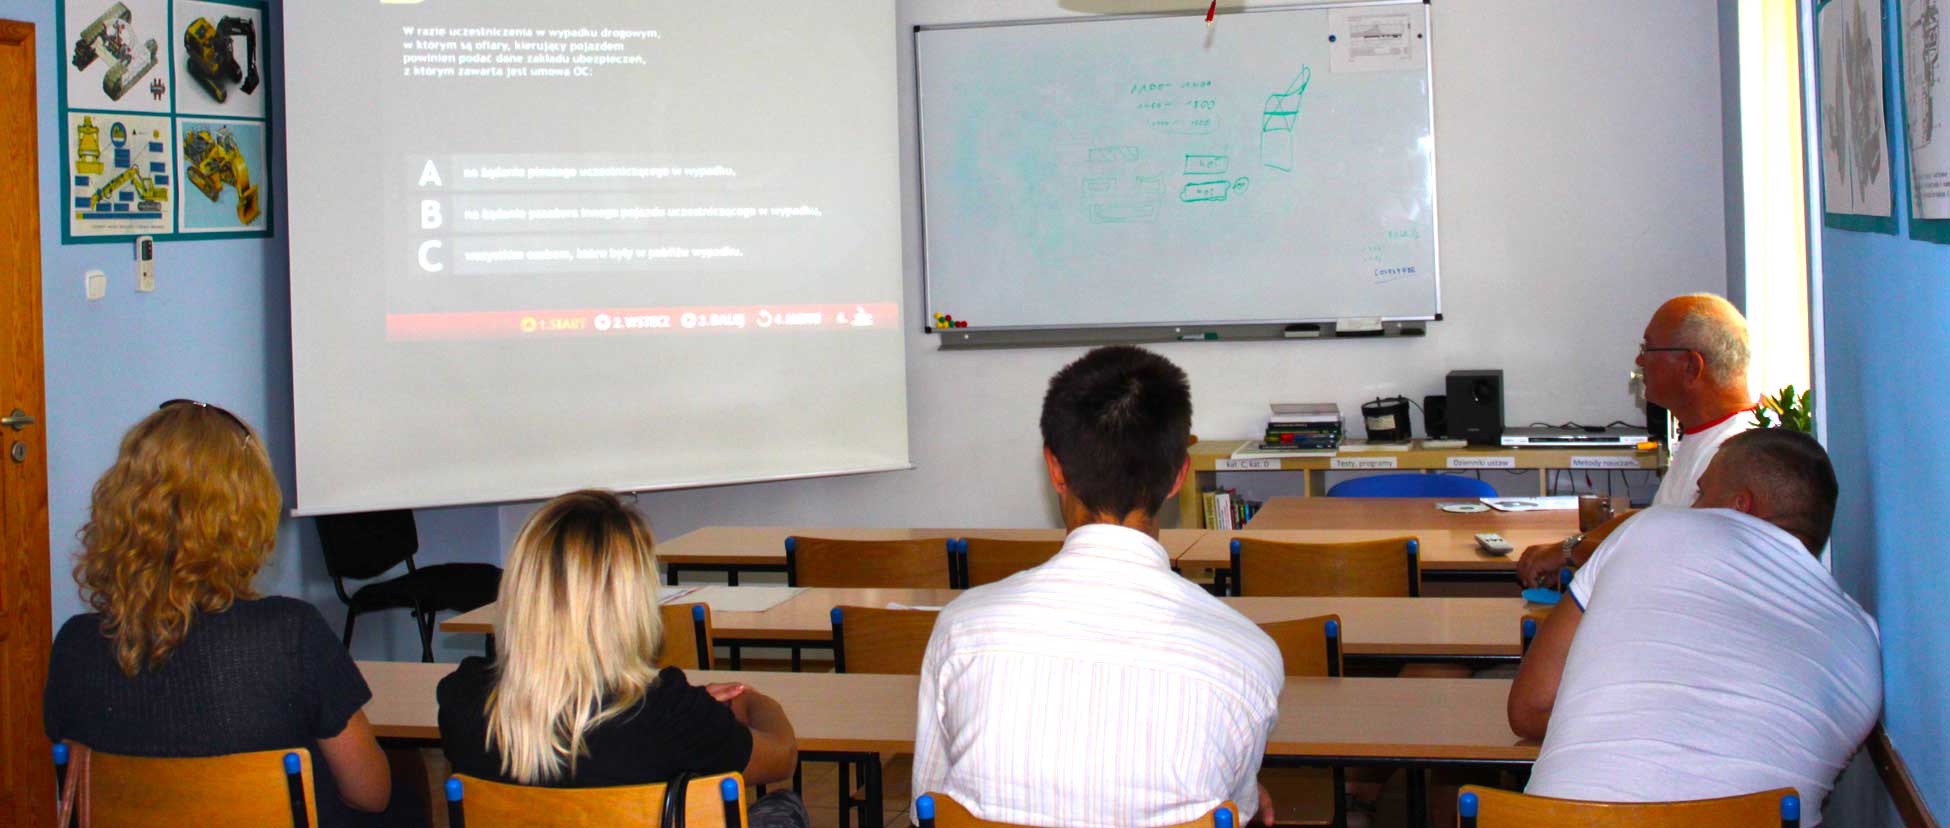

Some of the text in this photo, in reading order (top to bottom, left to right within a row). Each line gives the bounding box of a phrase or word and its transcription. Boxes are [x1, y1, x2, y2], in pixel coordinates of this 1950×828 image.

[403, 27, 414, 35] W
[417, 28, 446, 36] razie
[449, 27, 532, 36] uczestniczenia
[549, 28, 597, 39] wypadku
[601, 28, 660, 39] drogowym,
[416, 40, 456, 51] którym
[461, 42, 472, 51] są
[515, 41, 566, 52] kierujący
[570, 42, 624, 52] pojazdem
[404, 54, 646, 67] powinien podać dane zakładu ubezpieczeń,
[414, 66, 454, 77] którym
[458, 67, 503, 76] zawarta
[507, 67, 527, 78] jest
[530, 68, 570, 76] umowa
[573, 66, 592, 76] OC:
[418, 159, 443, 187] A
[672, 168, 682, 176] w
[420, 200, 443, 229] B
[418, 240, 444, 272] C
[636, 249, 646, 257] w
